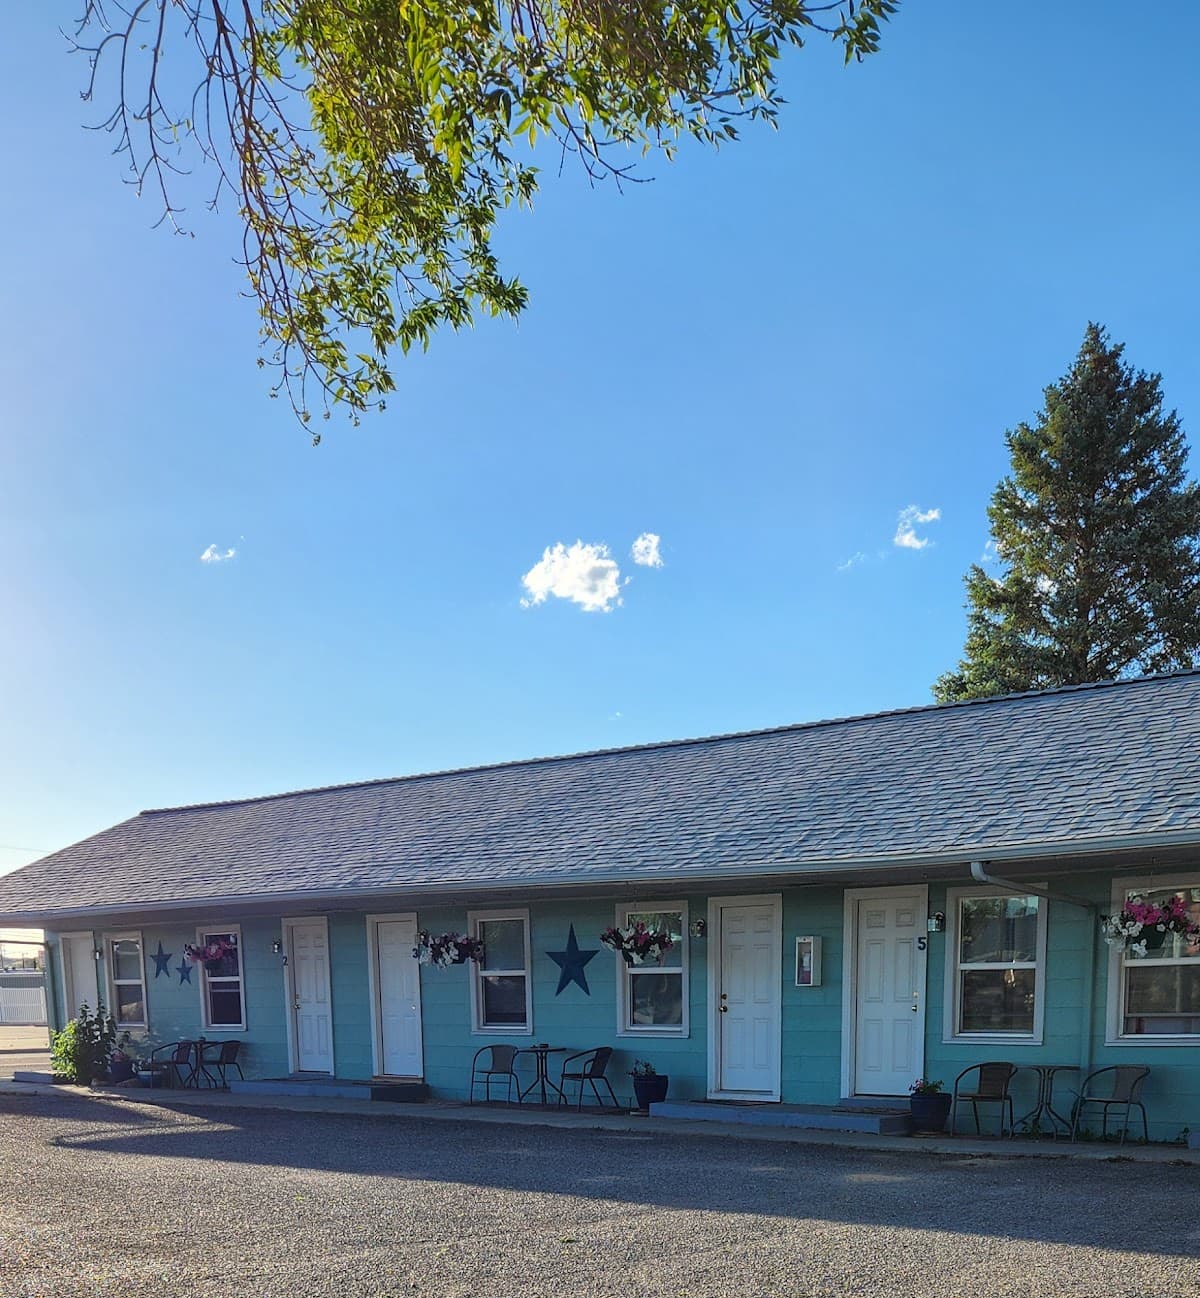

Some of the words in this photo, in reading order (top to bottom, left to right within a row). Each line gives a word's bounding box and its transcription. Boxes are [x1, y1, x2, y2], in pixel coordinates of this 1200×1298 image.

[917, 936, 927, 951] 5
[411, 947, 419, 959] 3
[282, 955, 289, 967] 2
